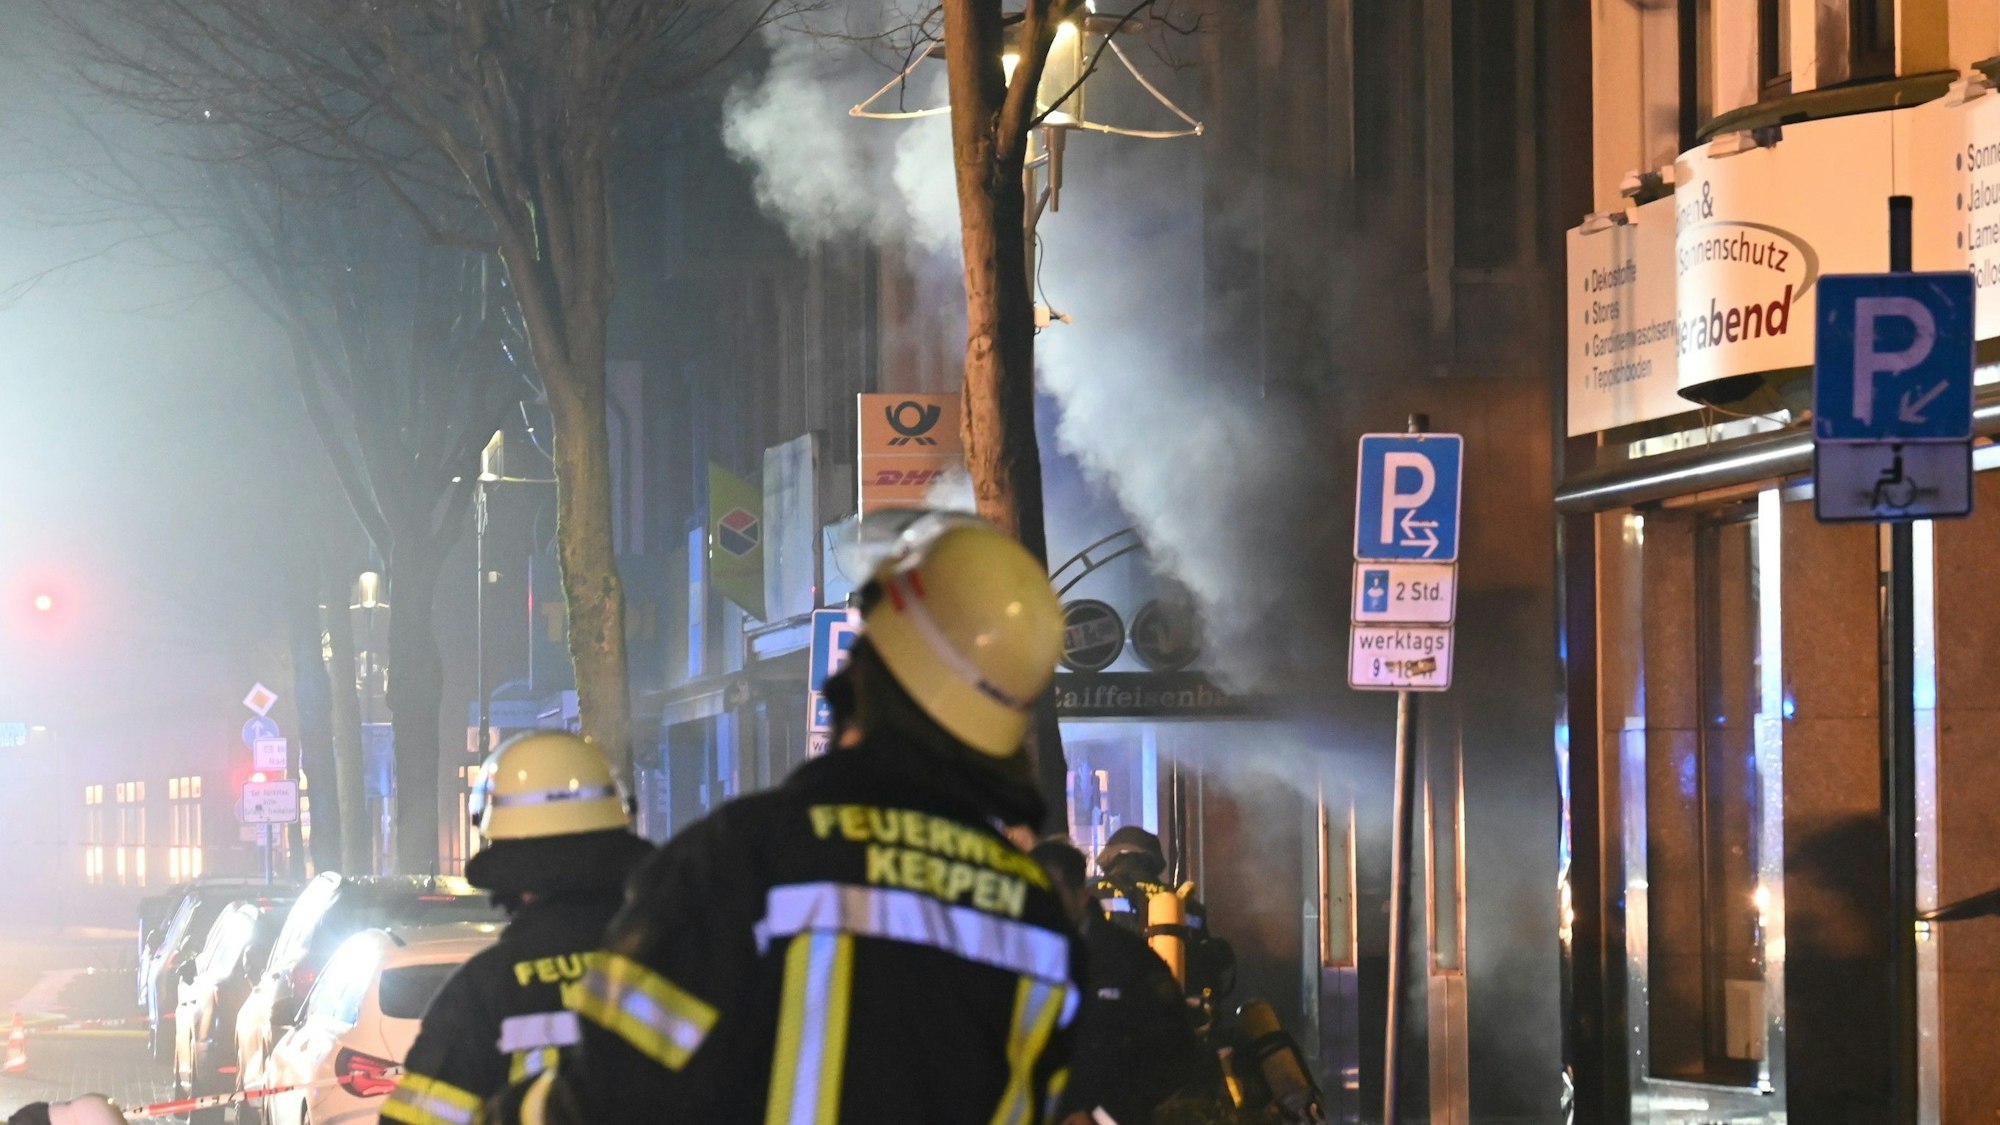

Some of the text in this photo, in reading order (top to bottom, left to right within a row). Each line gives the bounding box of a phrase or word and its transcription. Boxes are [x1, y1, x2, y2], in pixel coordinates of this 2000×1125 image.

[1701, 180, 1714, 219] &
[1968, 180, 2000, 212] Jalou
[1969, 217, 2000, 250] Lame
[1679, 231, 1789, 276] Sonnenschutz
[1592, 300, 1620, 325] Stores
[1852, 296, 1936, 427] P
[1380, 452, 1436, 545] P
[1396, 582, 1444, 601] 2 Std.
[1359, 630, 1445, 655] werktags
[1373, 658, 1380, 677] 9
[866, 843, 1027, 918] KERPEN
